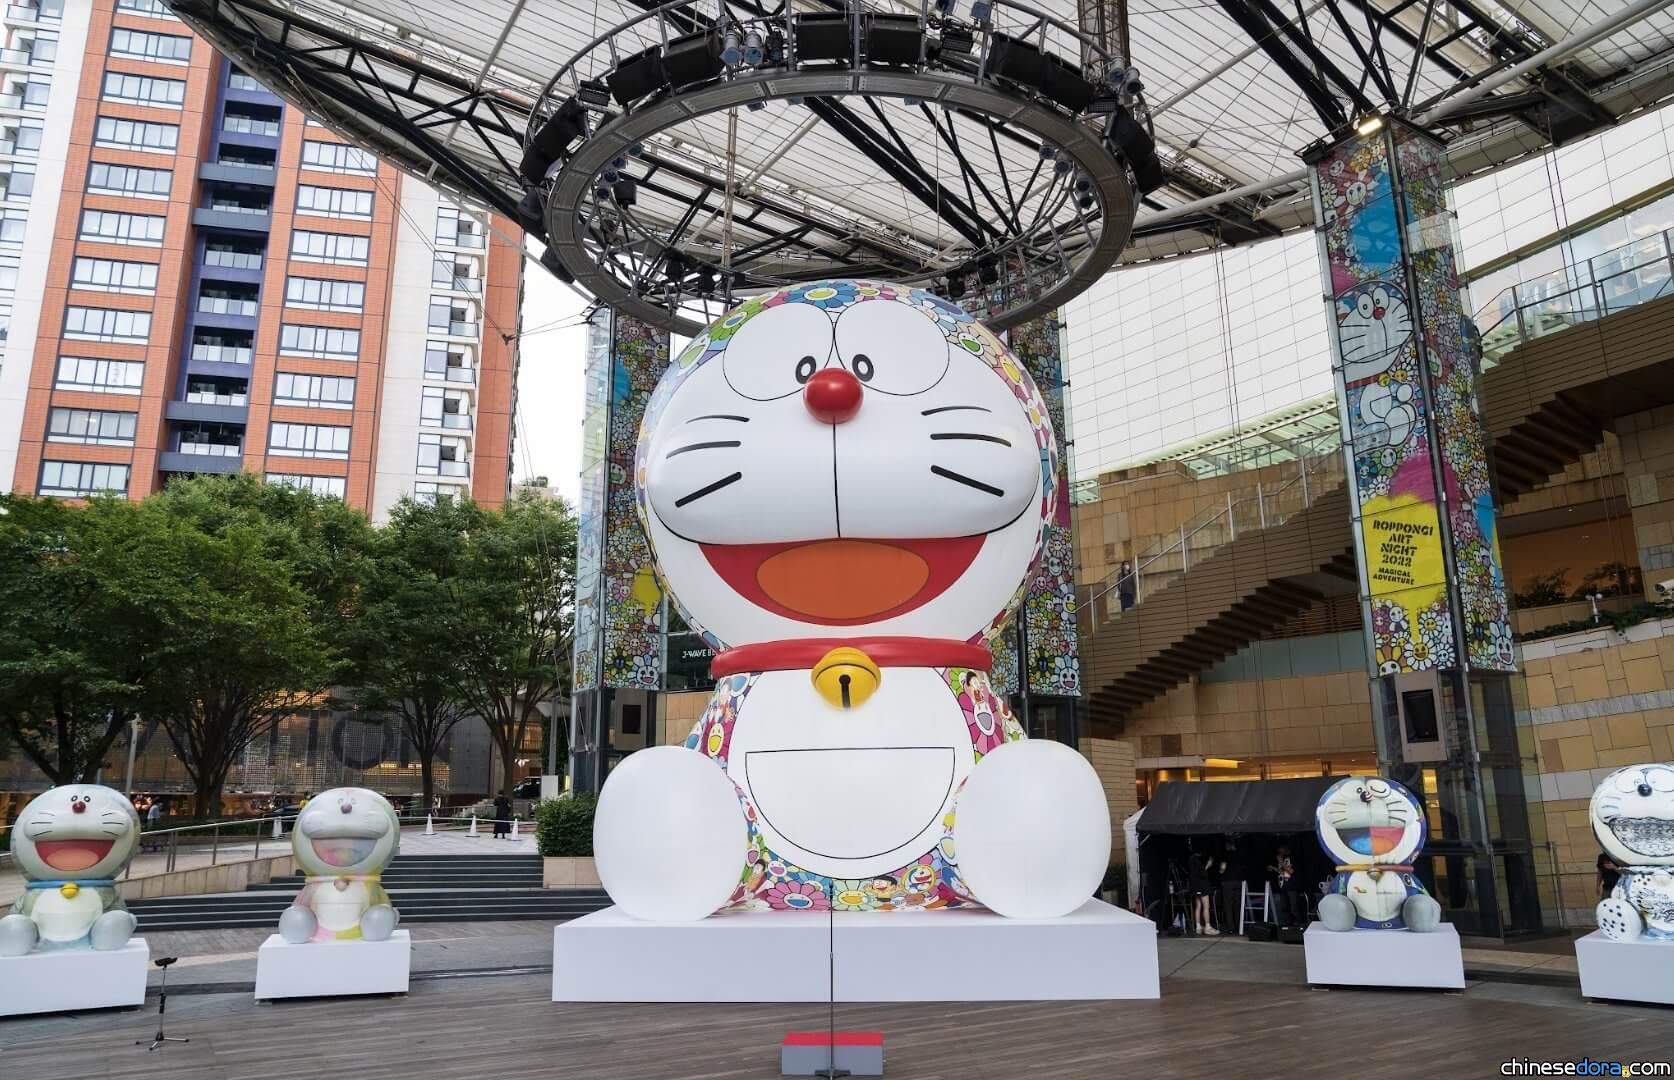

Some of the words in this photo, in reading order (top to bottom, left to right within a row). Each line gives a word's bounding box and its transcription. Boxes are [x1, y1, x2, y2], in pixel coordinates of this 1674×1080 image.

[1373, 520, 1433, 536] ROPPONGI
[1389, 533, 1413, 544] ART
[1381, 543, 1417, 557] NIGHT
[1382, 554, 1412, 567] 2022
[1379, 567, 1411, 577] MAGICAL
[1373, 574, 1415, 585] ADVENTURE
